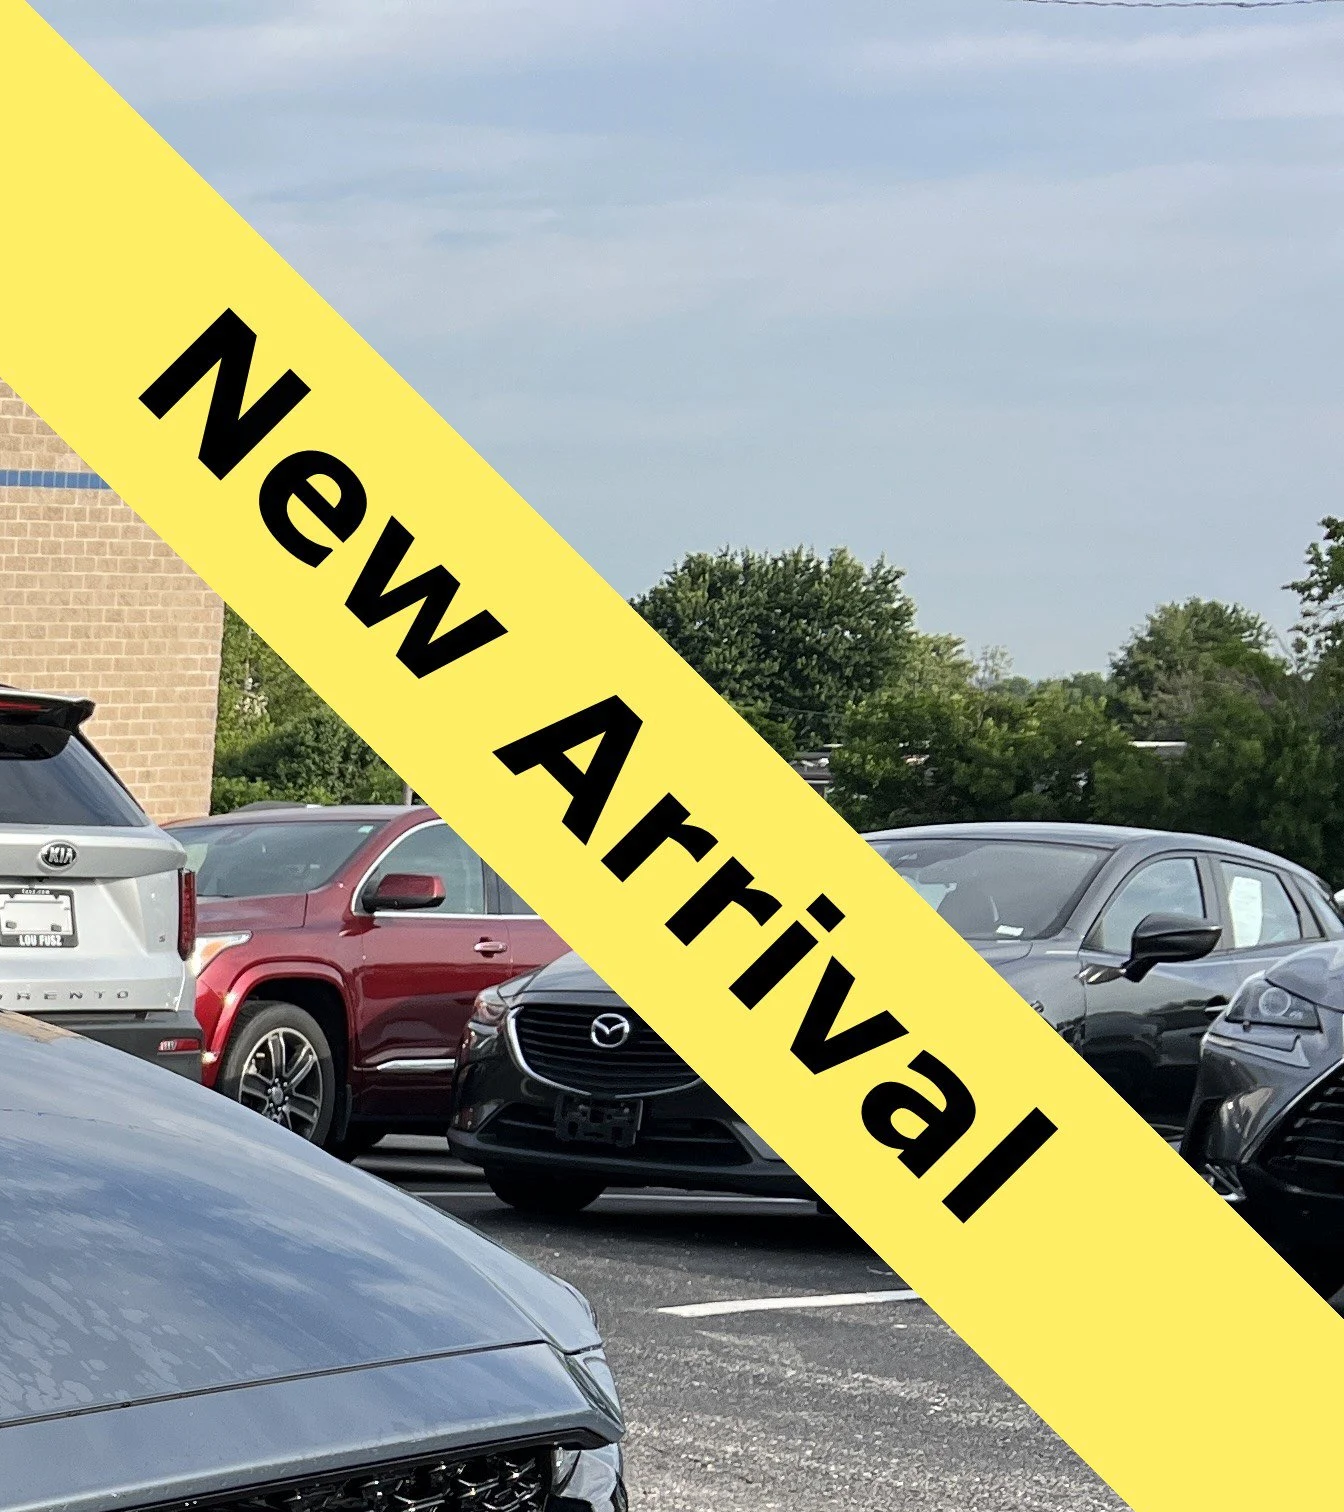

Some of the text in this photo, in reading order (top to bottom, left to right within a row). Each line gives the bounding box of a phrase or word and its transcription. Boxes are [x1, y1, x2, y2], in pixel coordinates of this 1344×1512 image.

[48, 846, 73, 864] KIA
[19, 934, 63, 947] LOU FUSZ
